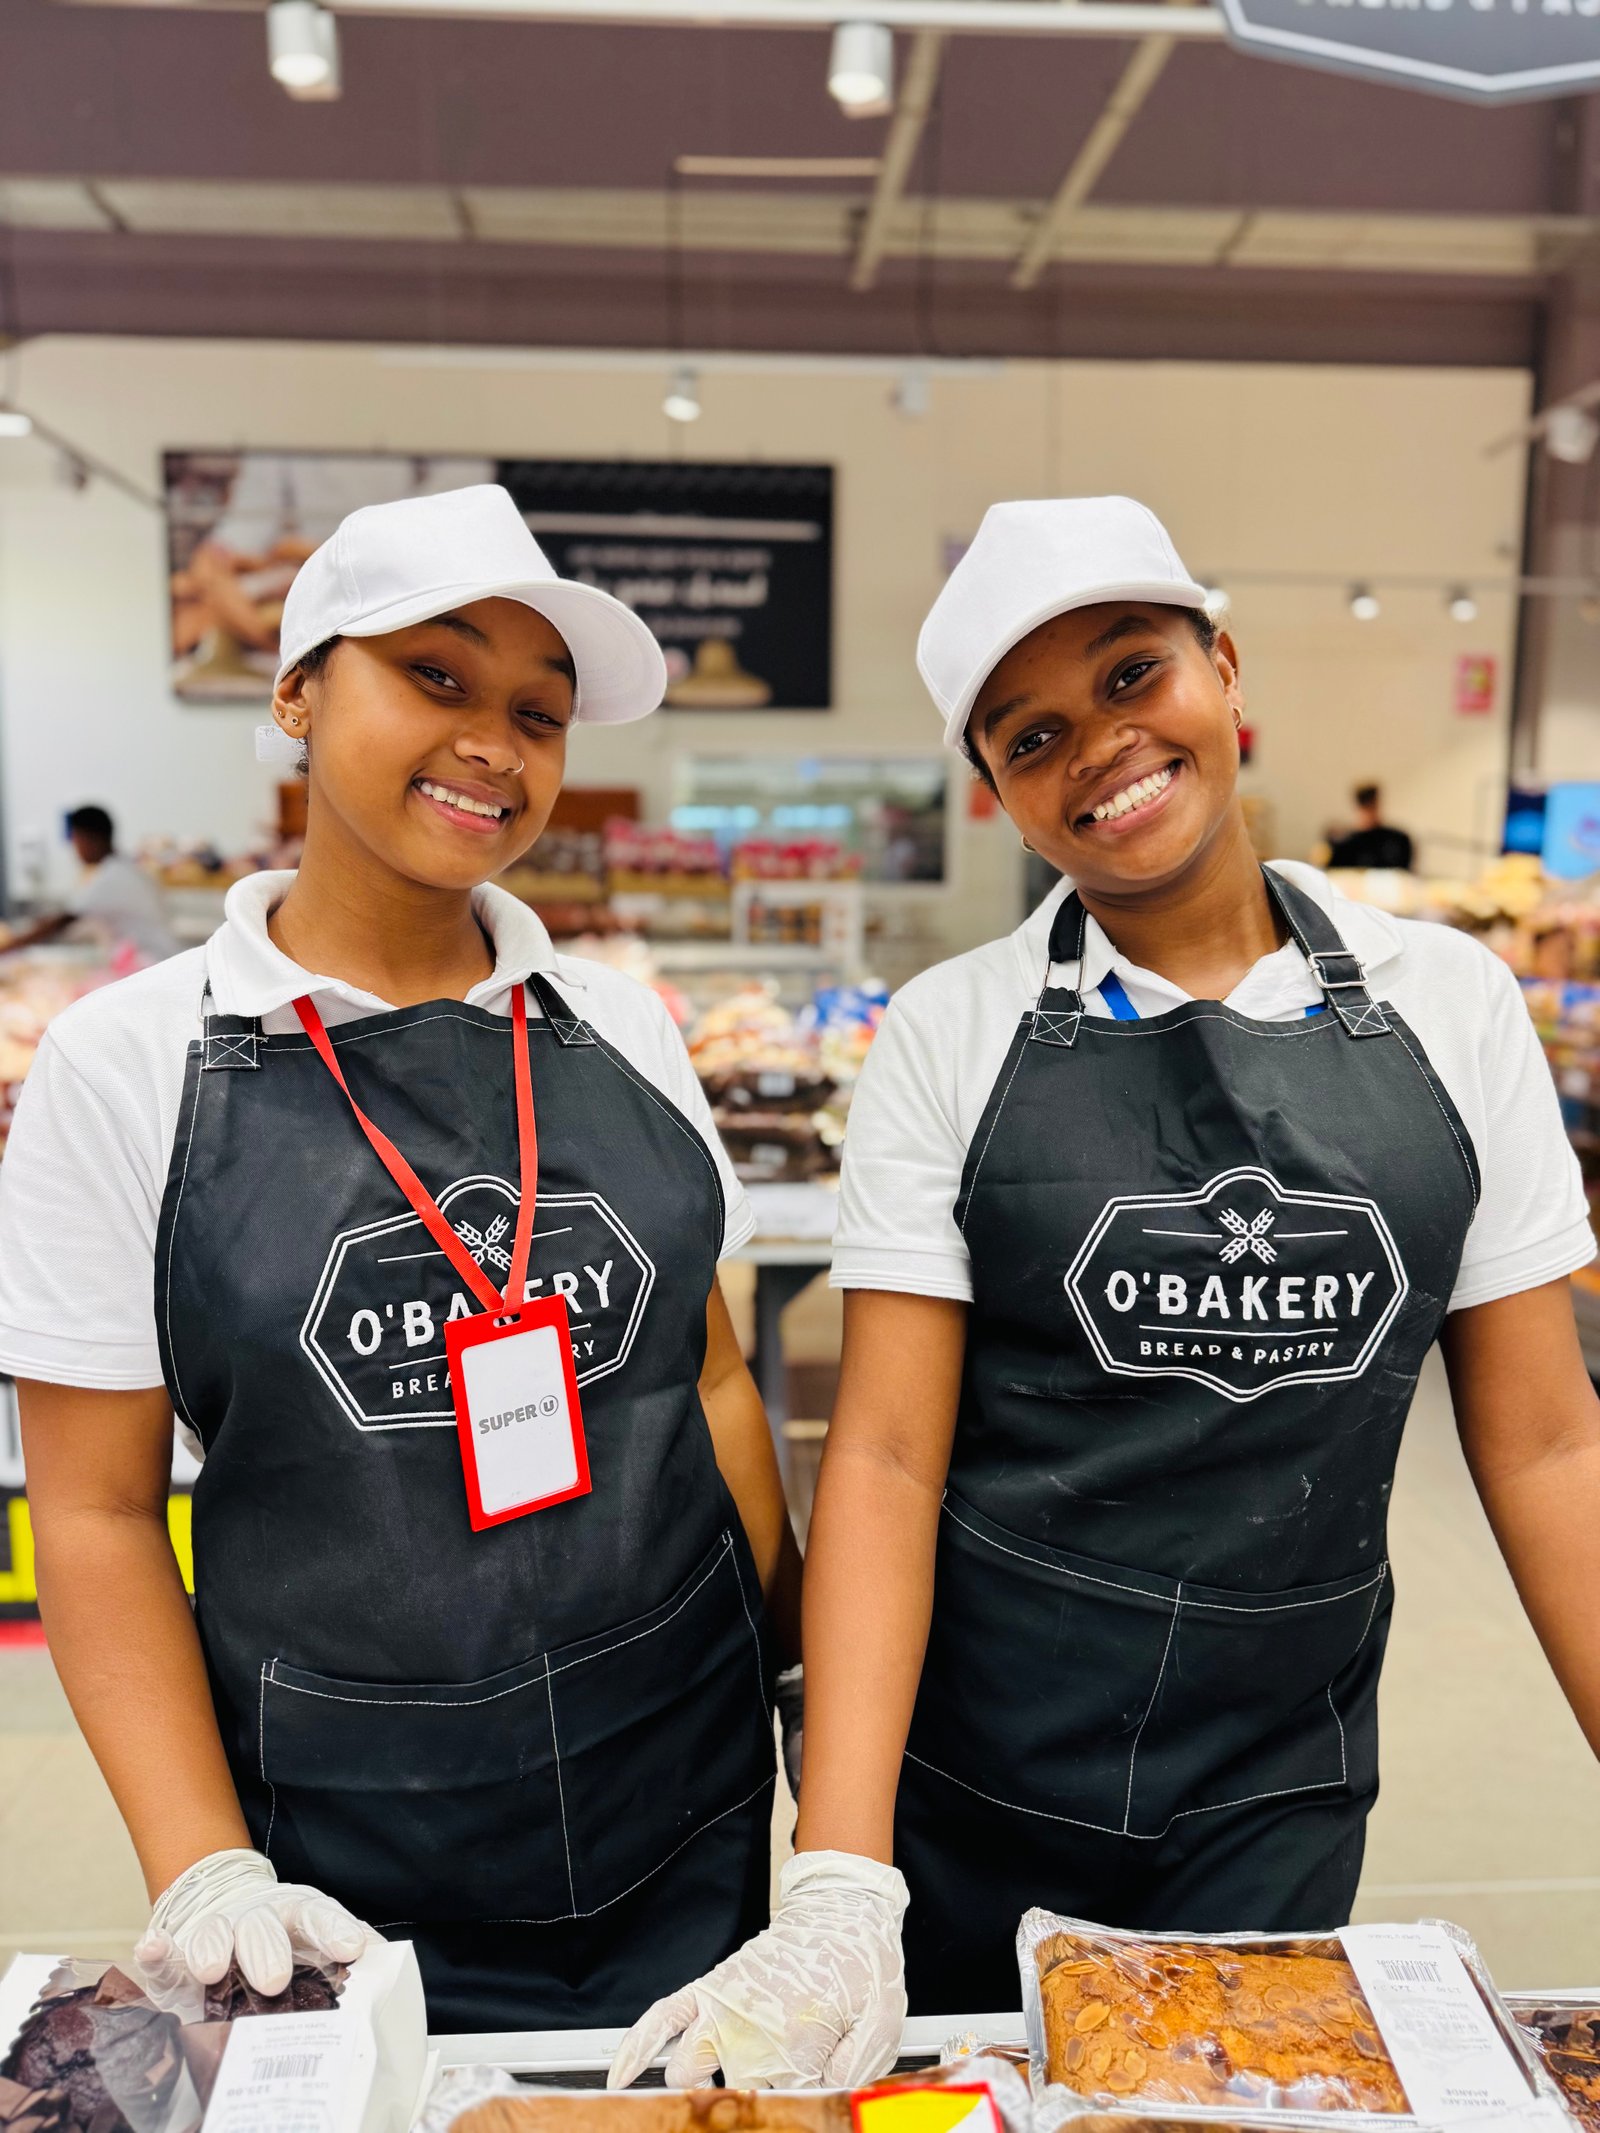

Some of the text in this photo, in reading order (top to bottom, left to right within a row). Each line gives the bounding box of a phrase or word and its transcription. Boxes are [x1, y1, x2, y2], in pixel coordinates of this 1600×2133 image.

[347, 1259, 614, 1357] O'BAERY
[1104, 1269, 1376, 1321] O'BAKERY
[1140, 1341, 1336, 1365] BREAD & PASTRY
[391, 1371, 452, 1399] BREA
[478, 1406, 538, 1435] SUPER
